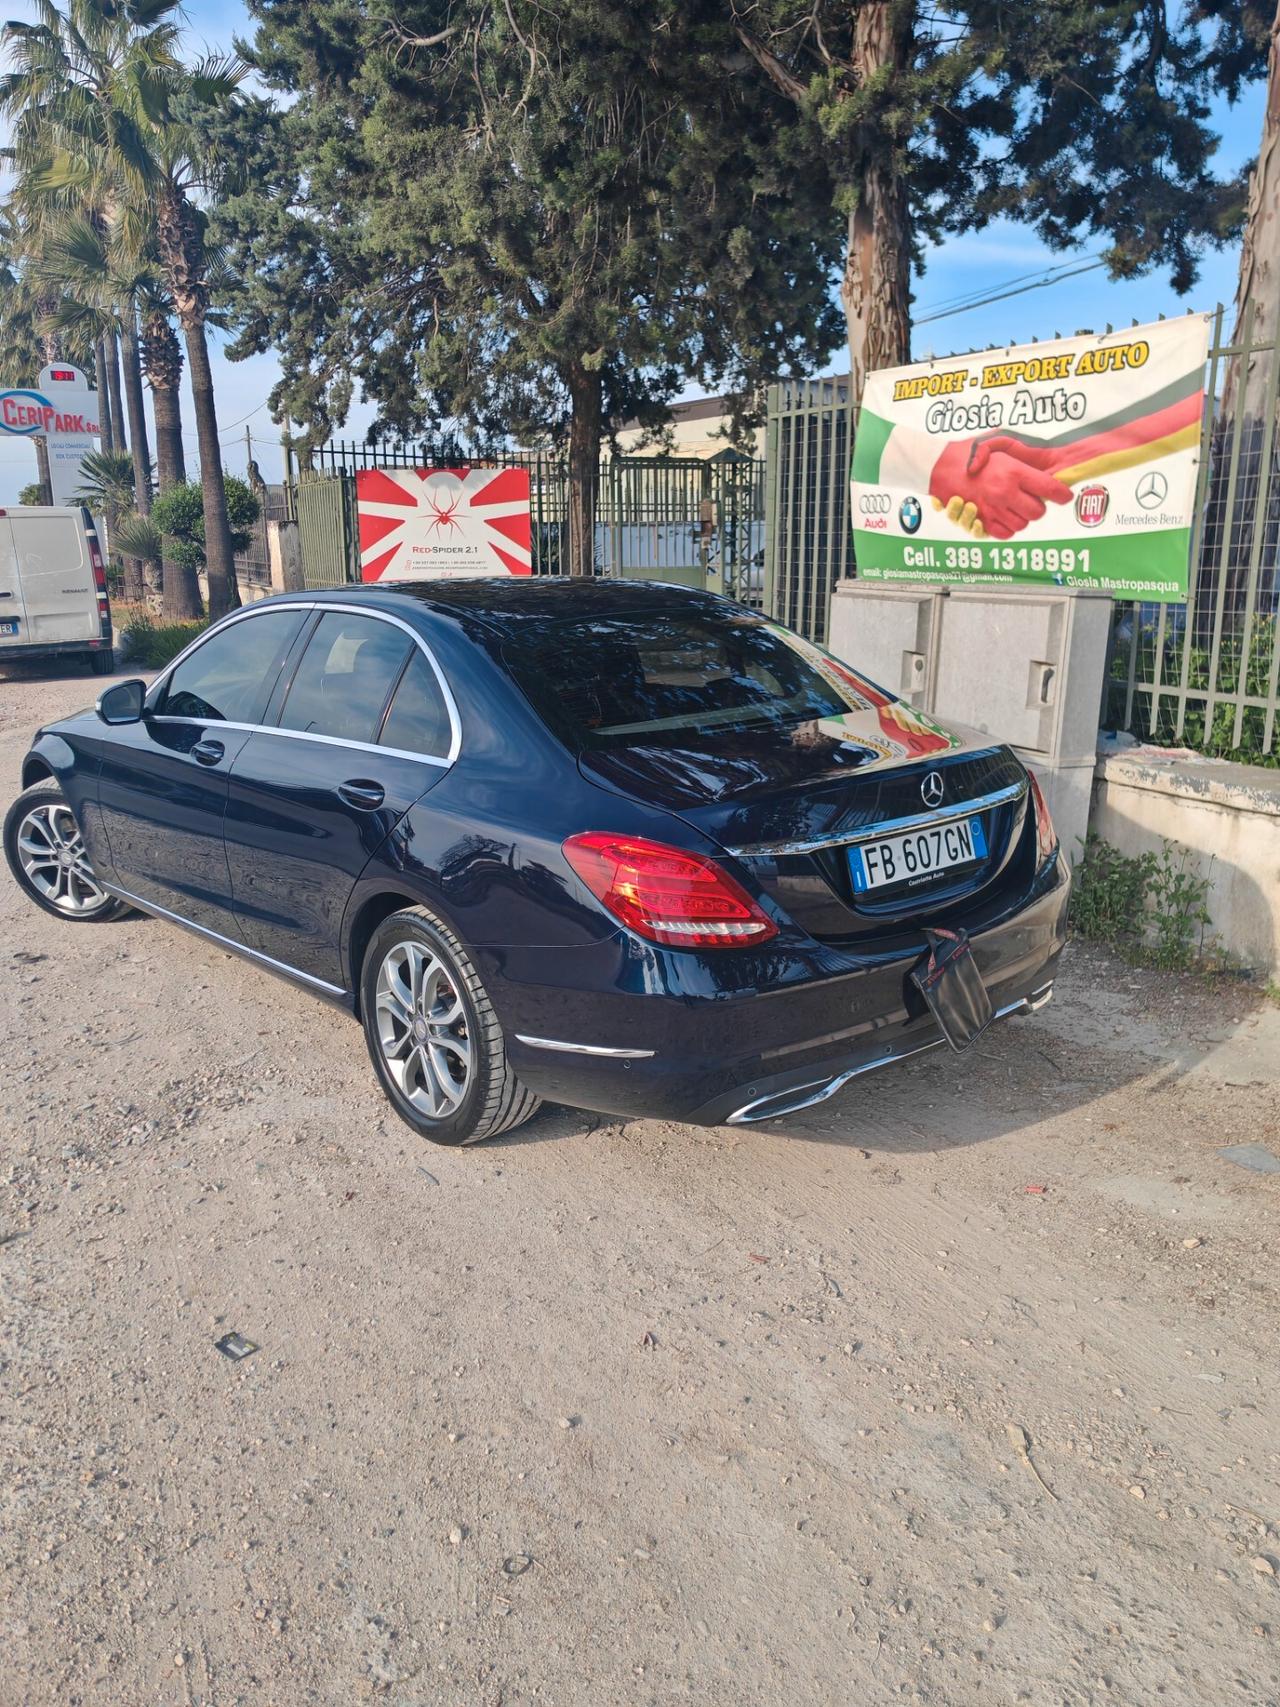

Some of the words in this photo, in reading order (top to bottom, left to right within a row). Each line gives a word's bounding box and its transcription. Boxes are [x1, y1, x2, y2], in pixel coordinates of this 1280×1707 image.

[892, 369, 968, 402] IMPORT
[980, 354, 1075, 389] EXPORT
[1075, 341, 1150, 376] AUTO
[926, 395, 1003, 434] Giosia
[1008, 388, 1087, 425] Auto
[1081, 494, 1104, 516] FIAT
[864, 518, 887, 529] Audi
[1115, 514, 1157, 526] Mercedes
[1160, 513, 1184, 525] Benz
[903, 546, 940, 567] Cell.
[945, 547, 982, 569] 389
[989, 548, 1091, 572] 1318991
[1066, 576, 1099, 588] Giosia
[1100, 577, 1180, 594] Mastropasqua
[864, 844, 896, 885] FB
[902, 823, 972, 873] 607GN
